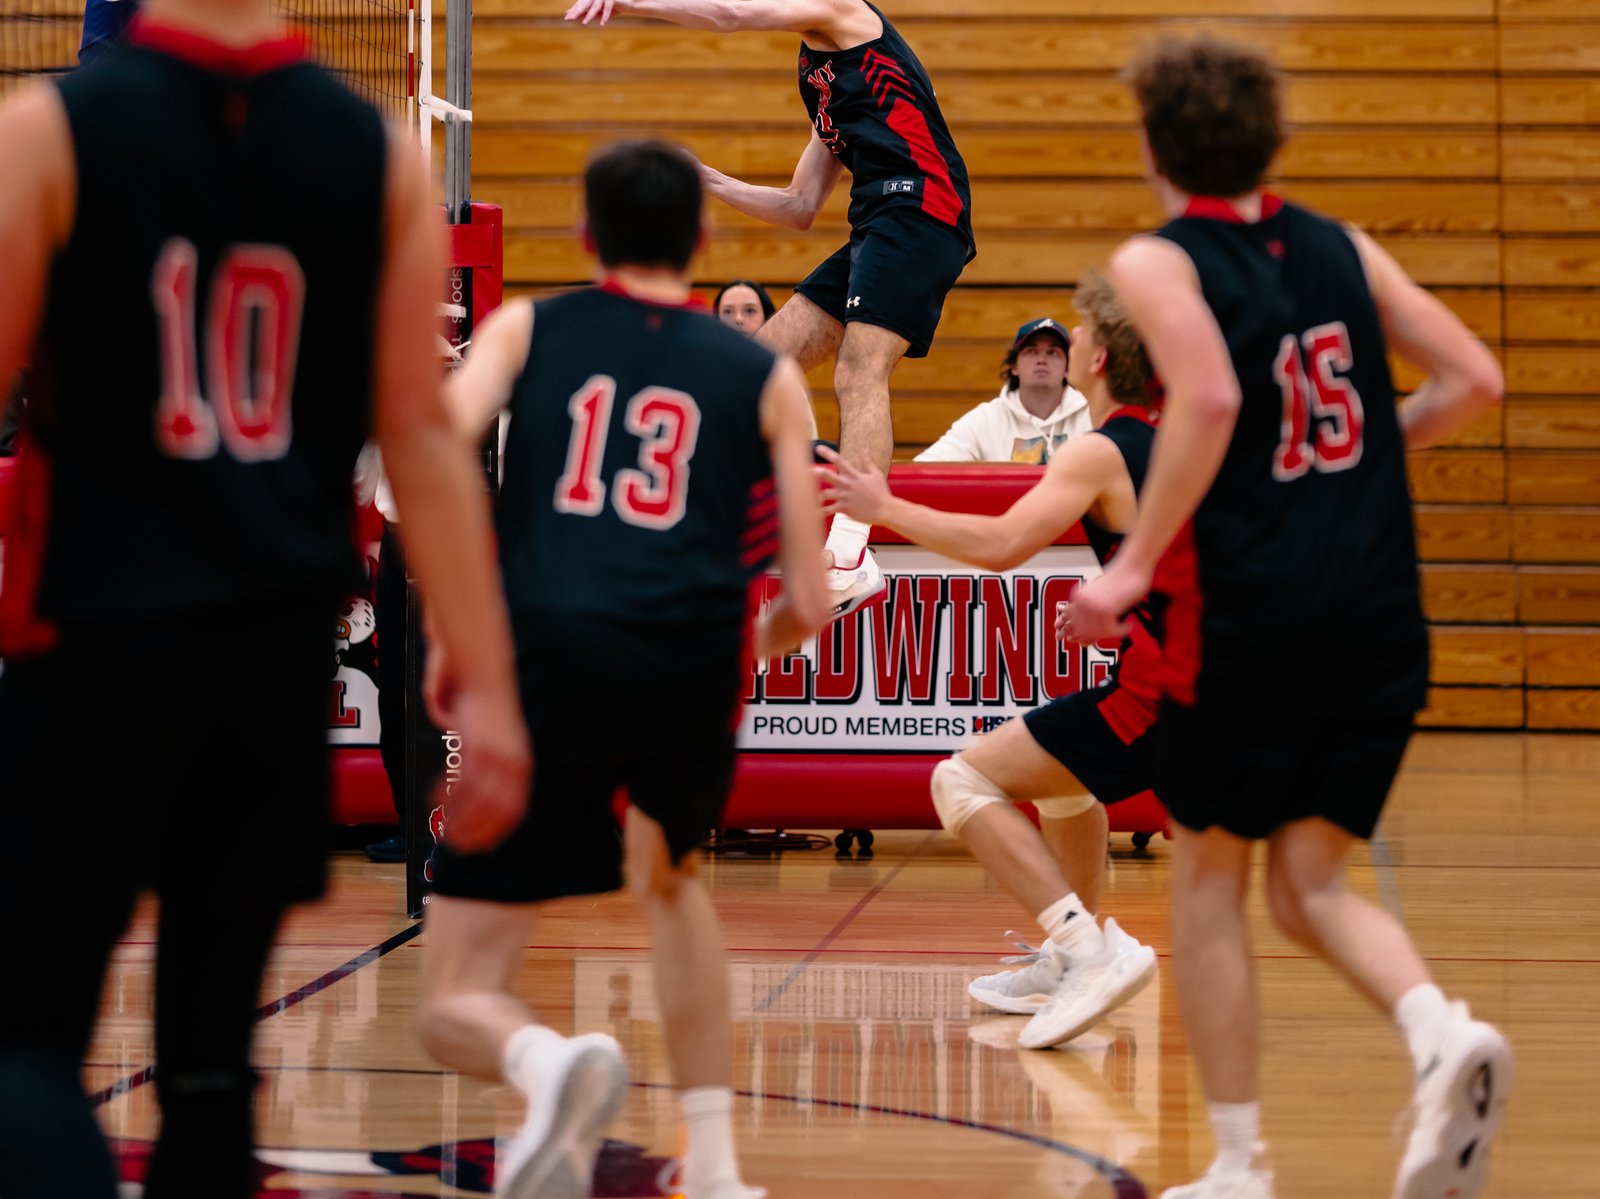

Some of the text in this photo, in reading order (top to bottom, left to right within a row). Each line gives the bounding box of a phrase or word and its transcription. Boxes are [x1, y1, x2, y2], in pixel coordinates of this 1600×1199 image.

[151, 235, 307, 463] 10
[1272, 320, 1365, 482] 15
[553, 373, 702, 532] 13
[753, 715, 837, 736] PROUD
[845, 716, 966, 737] MEMBERS
